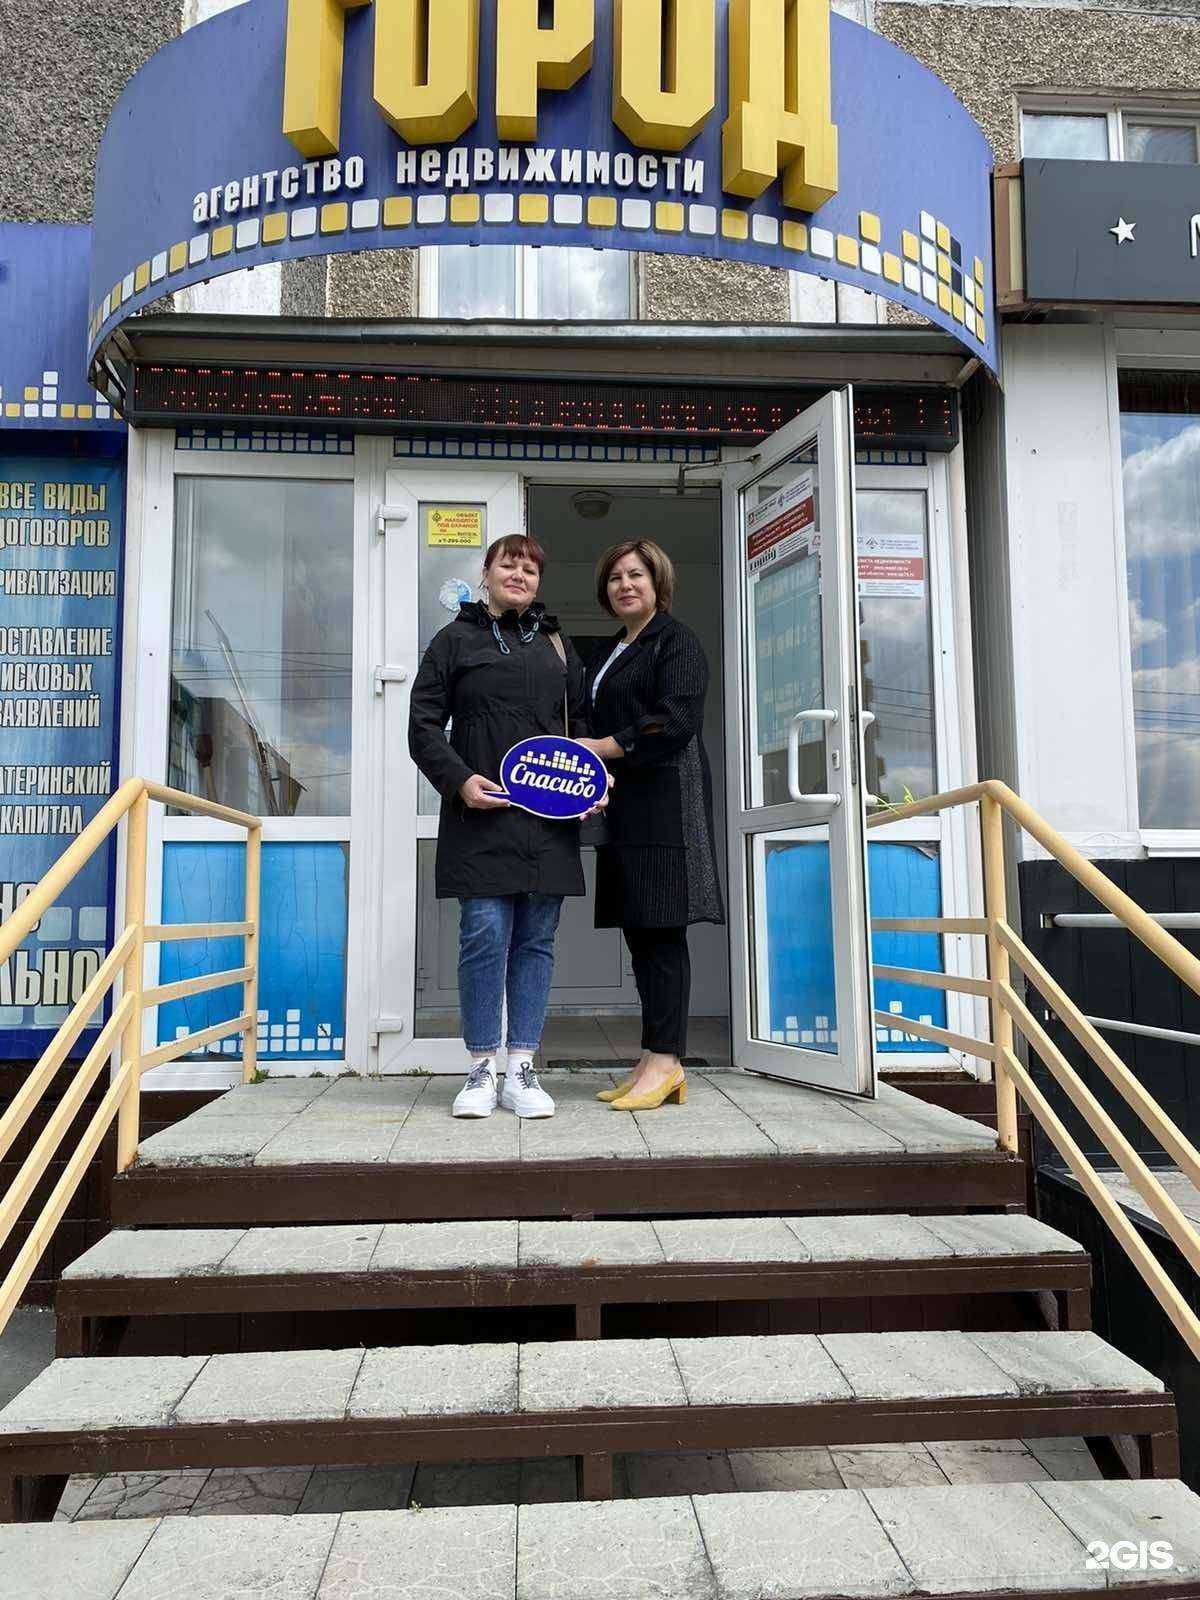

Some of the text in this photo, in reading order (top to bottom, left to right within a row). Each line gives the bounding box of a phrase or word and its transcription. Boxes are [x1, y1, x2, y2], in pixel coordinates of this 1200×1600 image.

[281, 0, 838, 212] ГОРОД
[193, 147, 705, 223] агентство недвижимости
[0, 482, 107, 515] ВСЕ ВИДЫ
[510, 763, 596, 798] Спасибо
[0, 805, 83, 835] КАПИТАЛ
